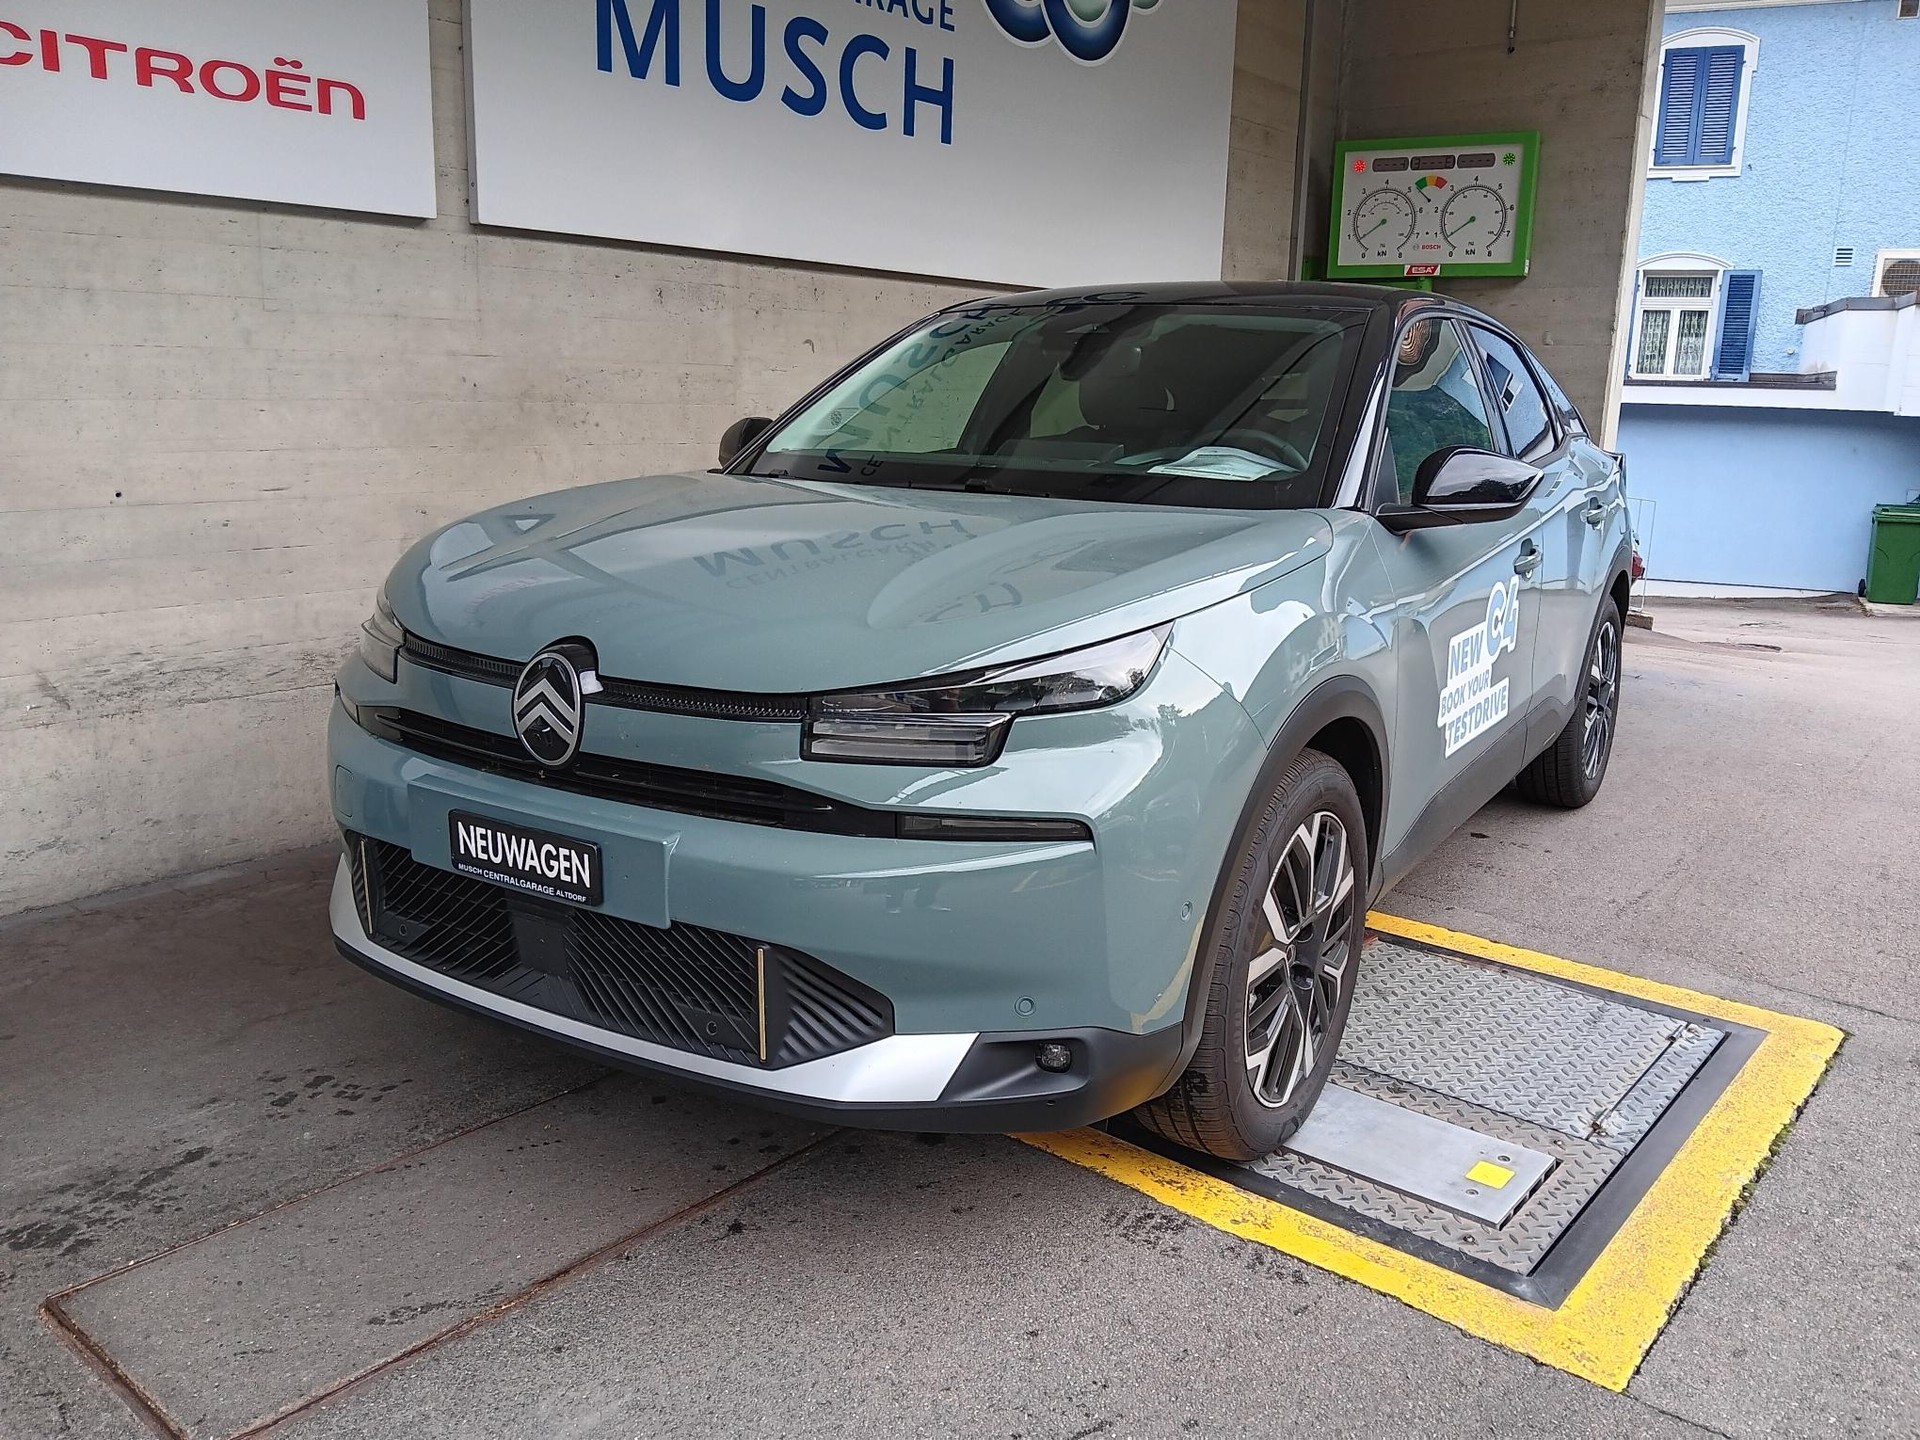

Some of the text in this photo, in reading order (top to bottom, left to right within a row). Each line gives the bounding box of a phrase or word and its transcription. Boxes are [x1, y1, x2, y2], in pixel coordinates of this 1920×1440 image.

[596, 0, 955, 145] MUSCH
[1449, 582, 1519, 681] NEW C4
[1440, 669, 1490, 718] BOOK YOUR
[1446, 685, 1508, 749] TESTDRIVE
[456, 821, 592, 889] NEUWAGEN
[457, 862, 588, 903] MUSCH CENTRALGARAGE ALTDORF
